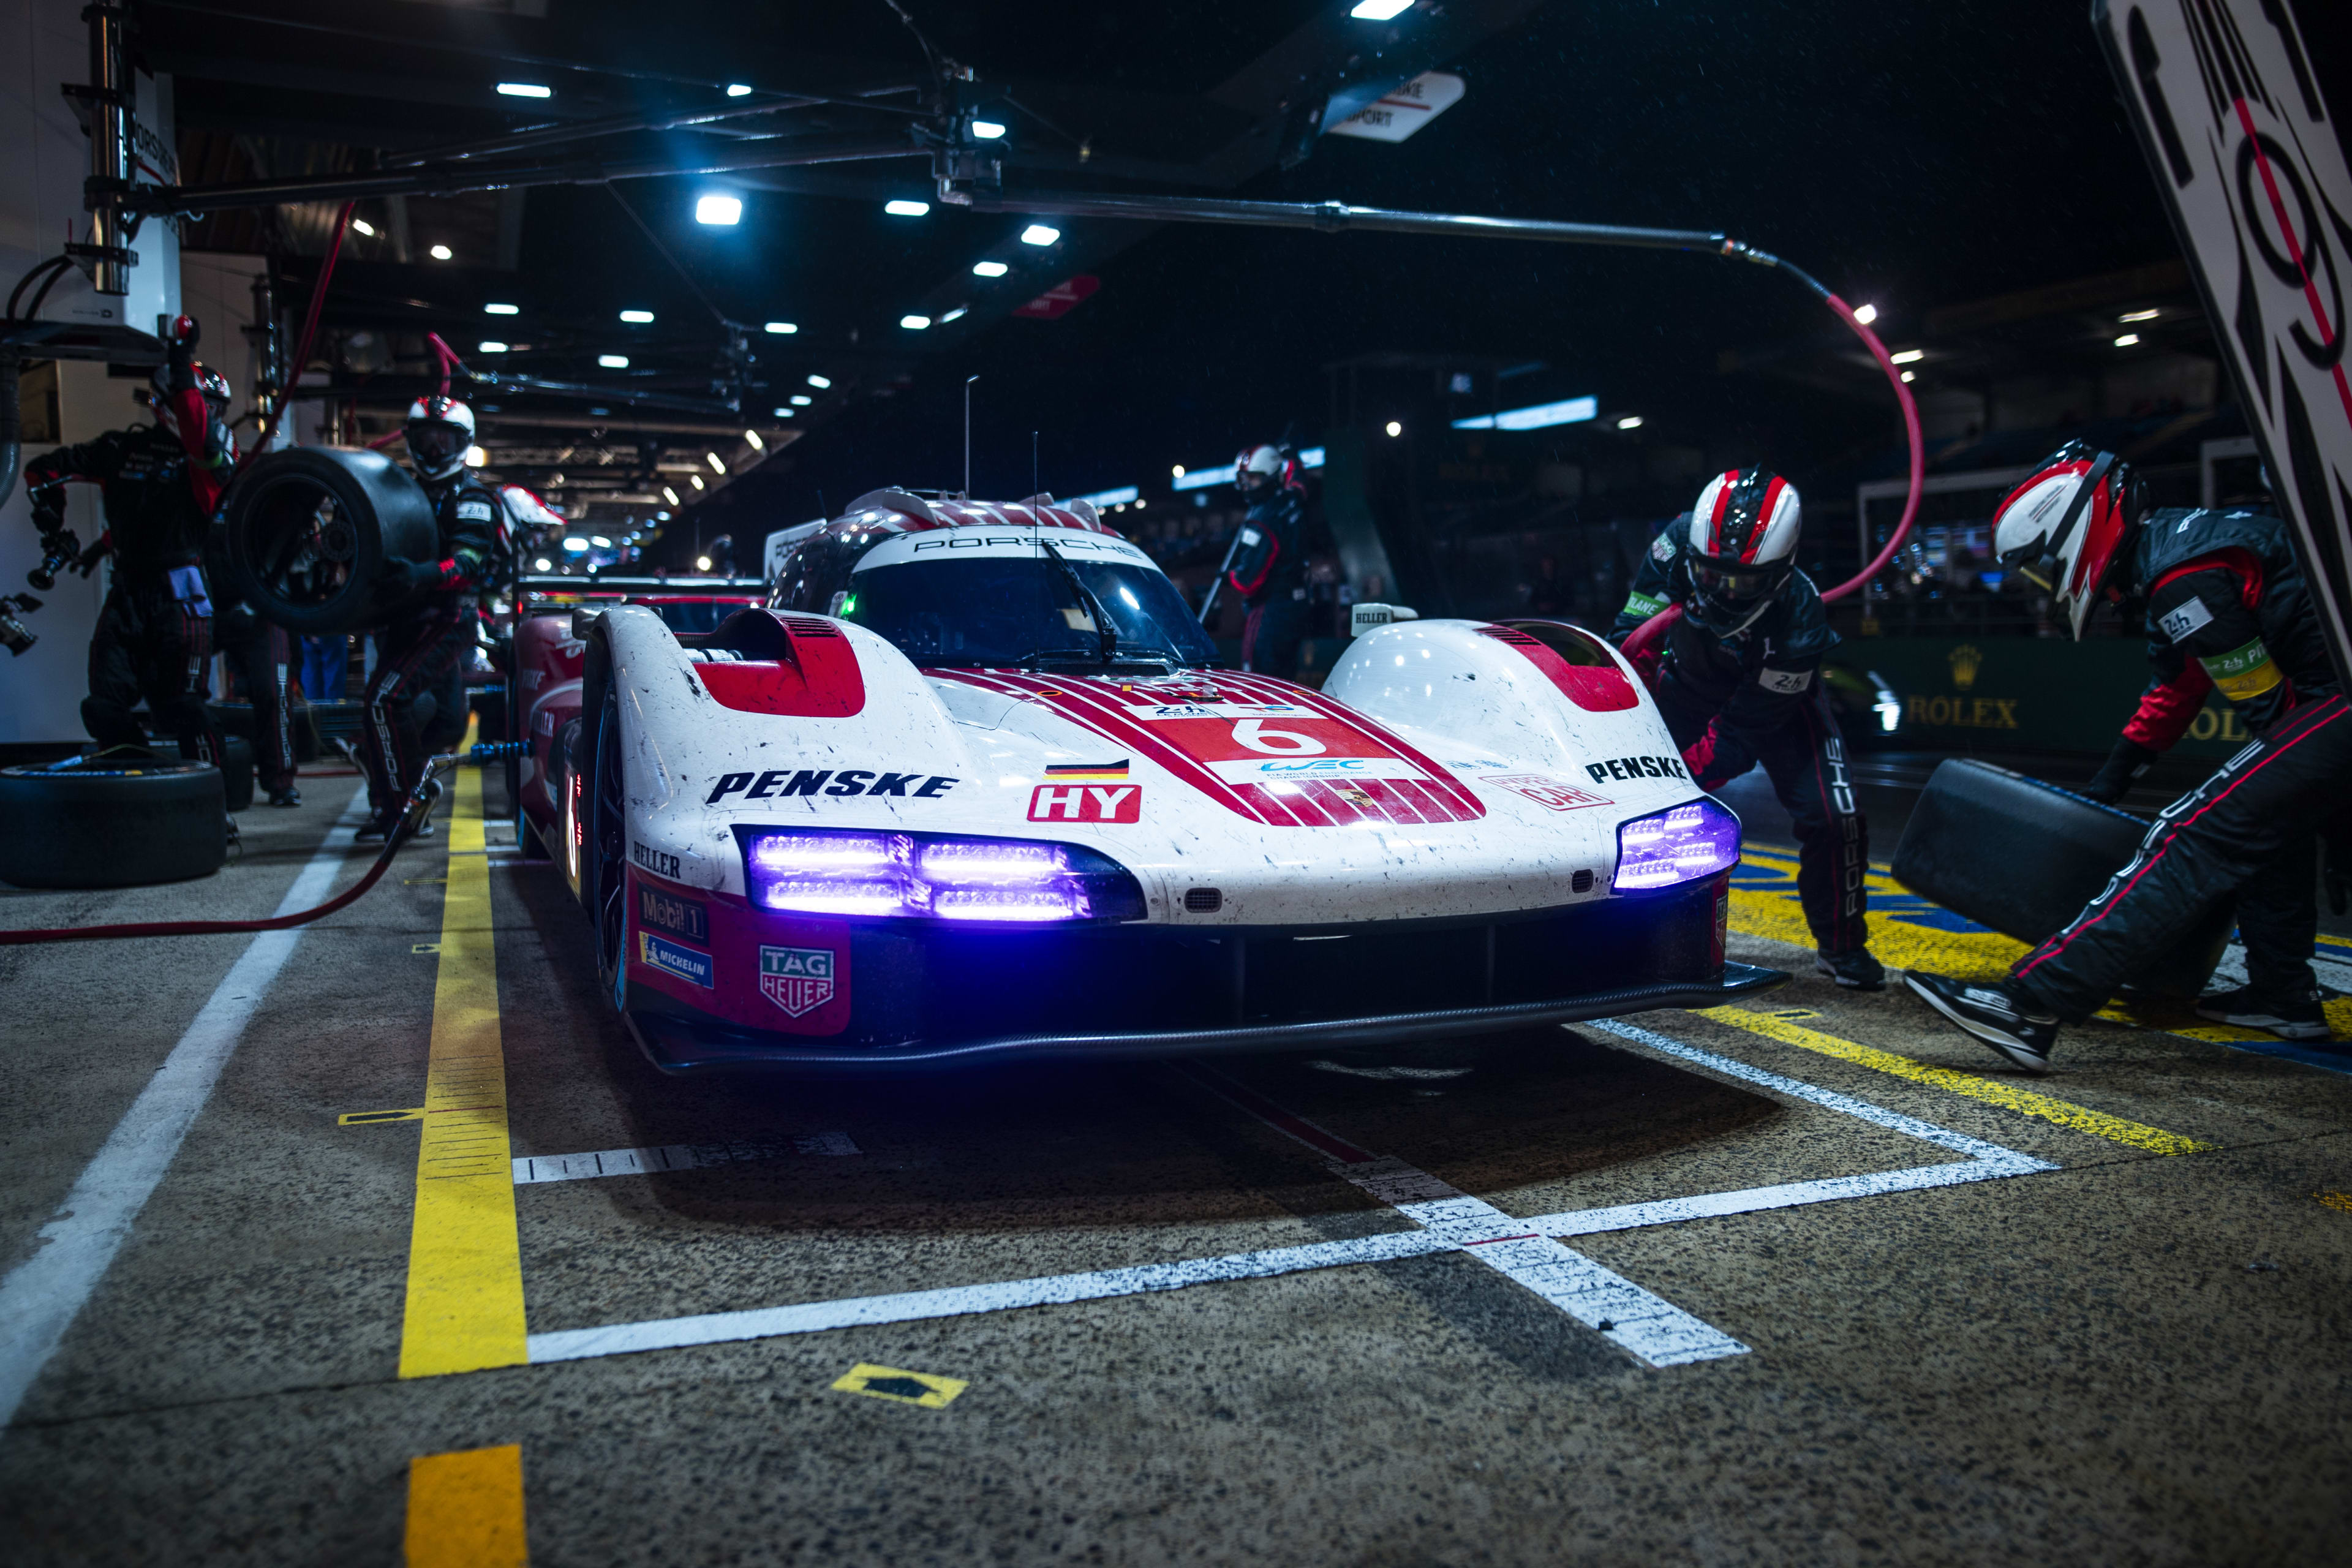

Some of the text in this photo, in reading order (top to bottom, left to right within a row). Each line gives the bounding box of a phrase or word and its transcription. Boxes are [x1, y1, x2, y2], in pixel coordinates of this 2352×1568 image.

[914, 537, 1142, 559] PORSCHE
[1355, 612, 1388, 624] HELLER
[1907, 694, 2019, 729] ROLEX
[372, 670, 402, 792] PORSCHE
[1232, 719, 1327, 756] 6
[1261, 760, 1365, 772] WEC
[1585, 756, 1687, 784] PENSKE
[705, 770, 960, 805] PENSKE
[1489, 776, 1561, 790] HYPER
[1520, 786, 1603, 806] CAR
[1033, 787, 1136, 819] HY
[1825, 737, 1860, 917] PORSCHE
[633, 840, 681, 880] HELLER
[643, 891, 685, 932] Mobil
[659, 949, 705, 976] MICHELIN
[765, 951, 827, 975] TAG
[764, 977, 828, 1011] HEUER
